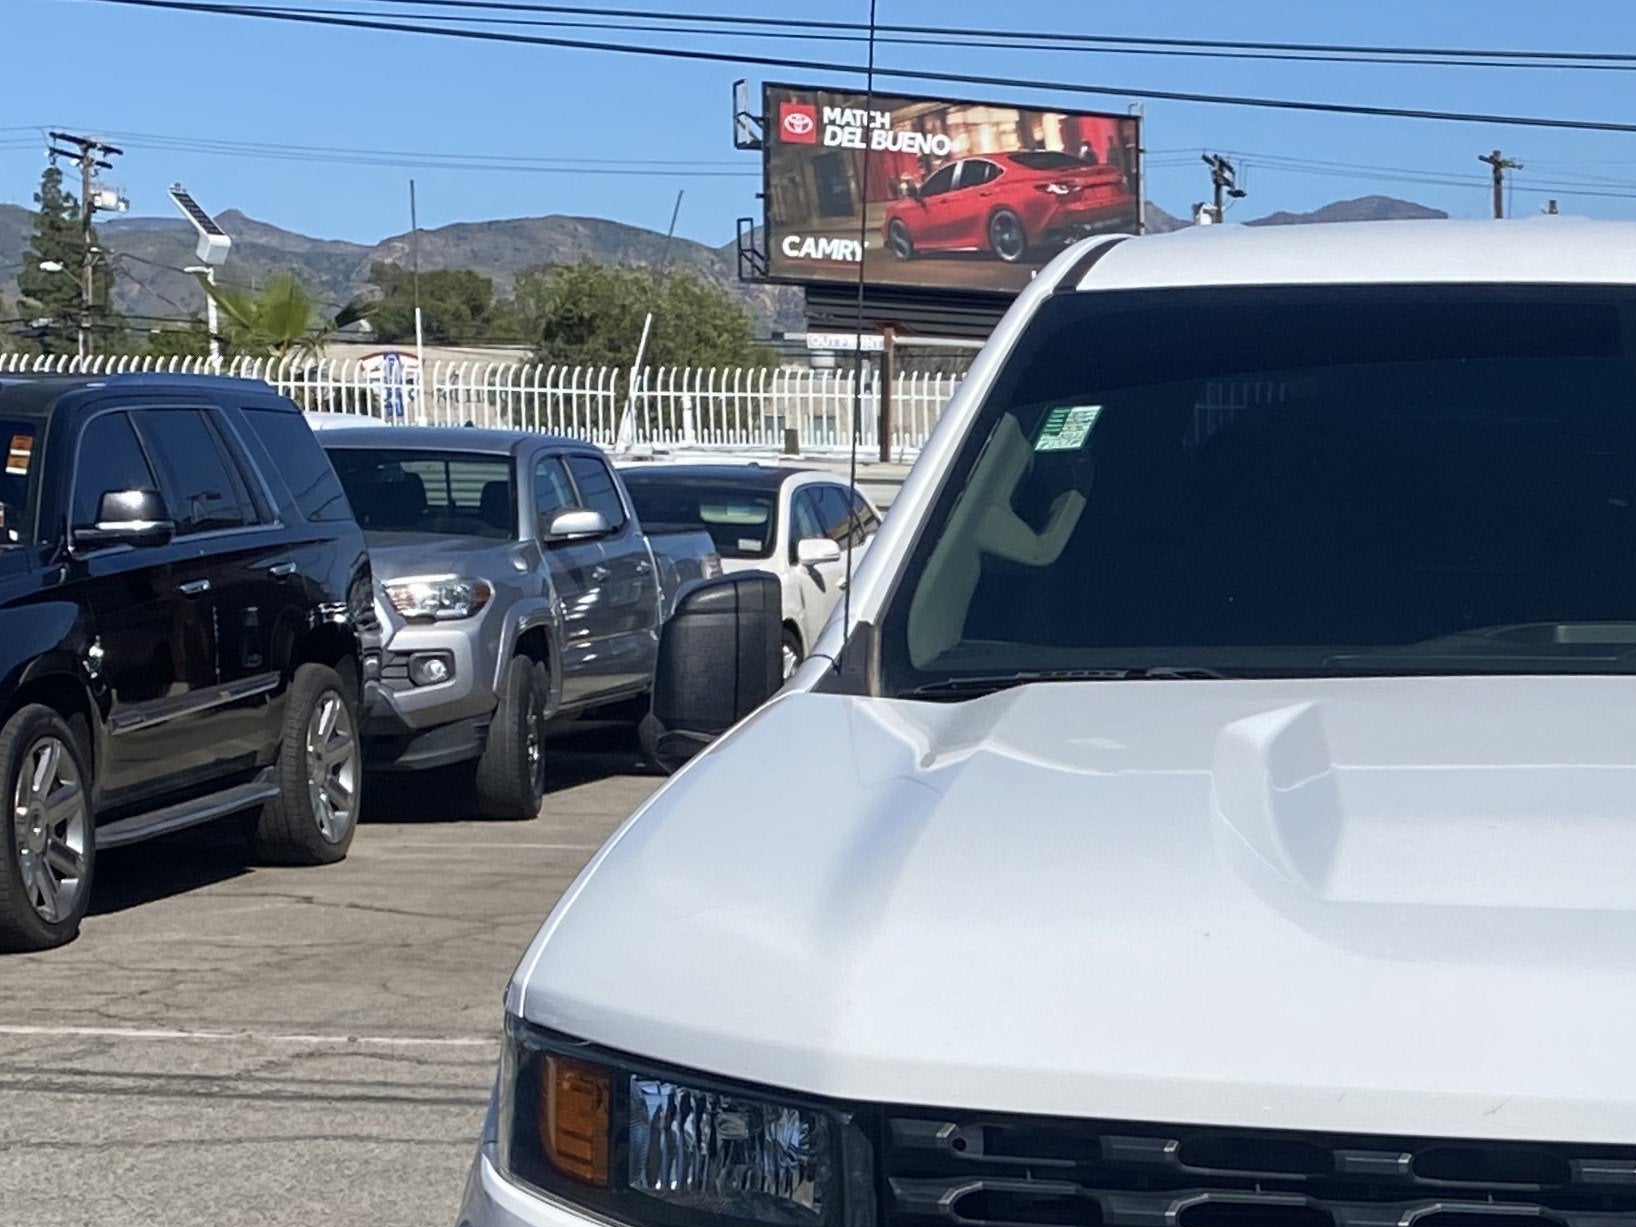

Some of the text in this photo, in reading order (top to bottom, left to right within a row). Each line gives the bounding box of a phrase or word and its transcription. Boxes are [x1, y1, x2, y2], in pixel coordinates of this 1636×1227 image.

[822, 106, 891, 130] MATCH
[823, 125, 951, 156] DEL BUENO
[782, 235, 869, 263] CAMRY
